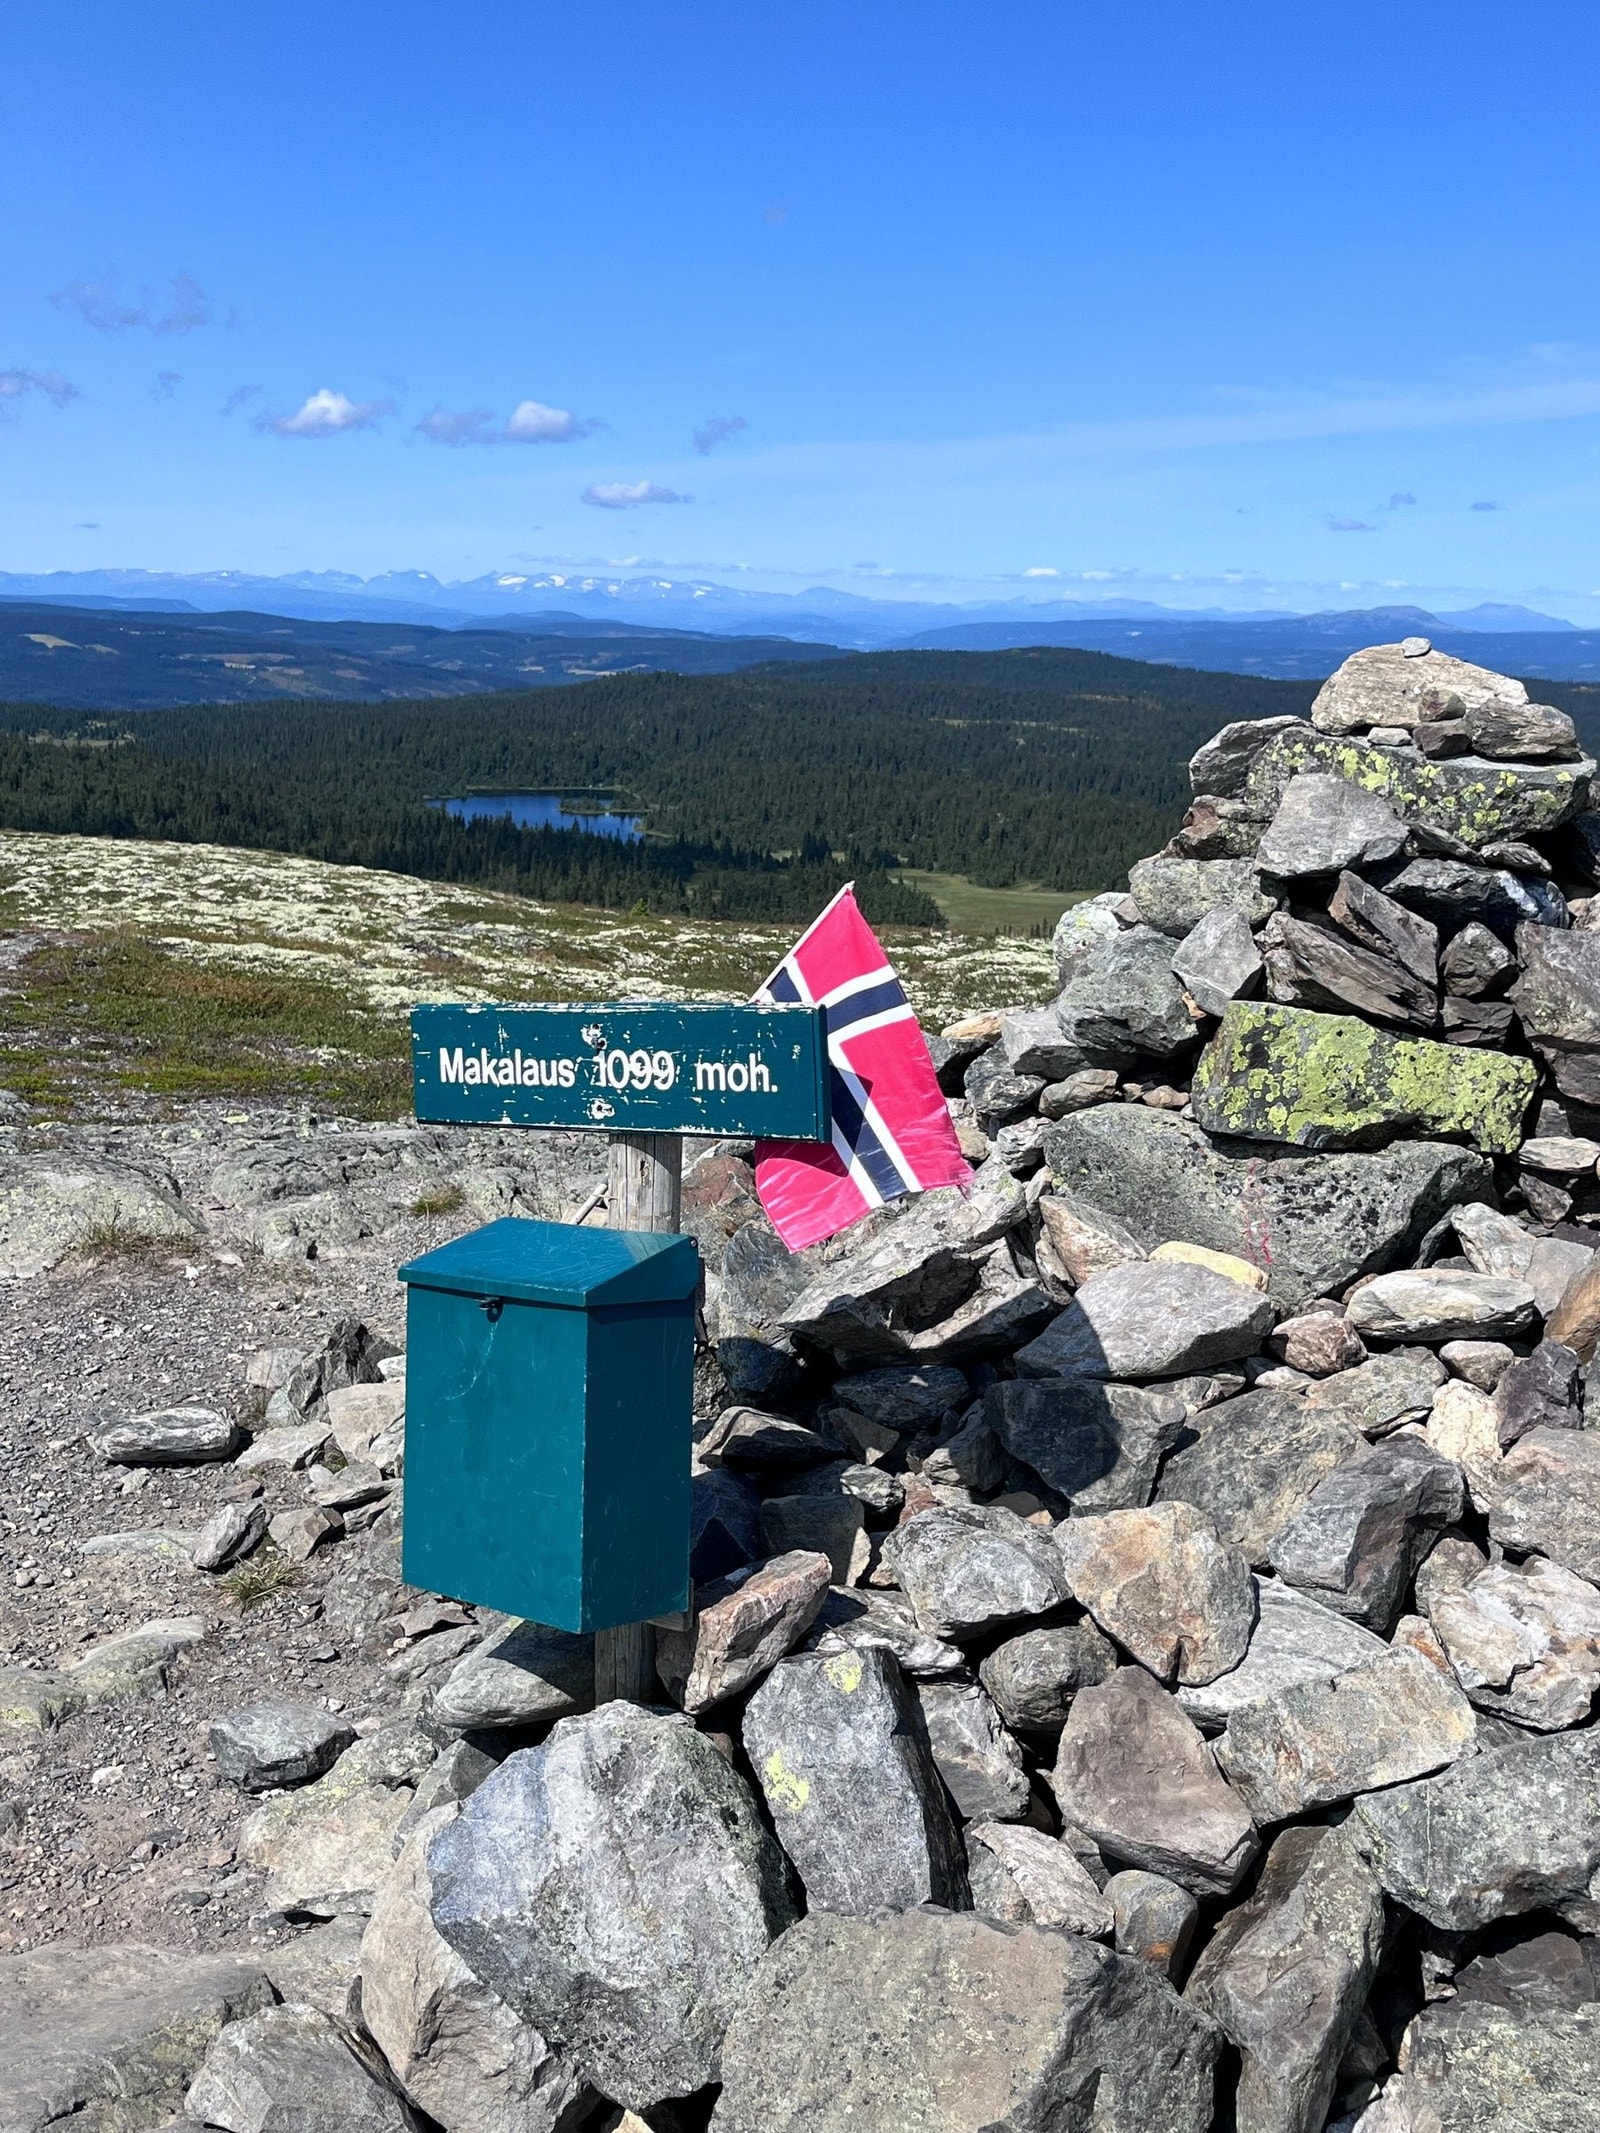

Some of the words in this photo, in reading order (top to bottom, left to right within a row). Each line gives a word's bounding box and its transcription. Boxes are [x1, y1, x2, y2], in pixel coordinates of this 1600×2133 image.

[439, 1047, 575, 1087] Makalaus
[592, 1049, 675, 1090] 1099
[696, 1053, 778, 1092] moh.
